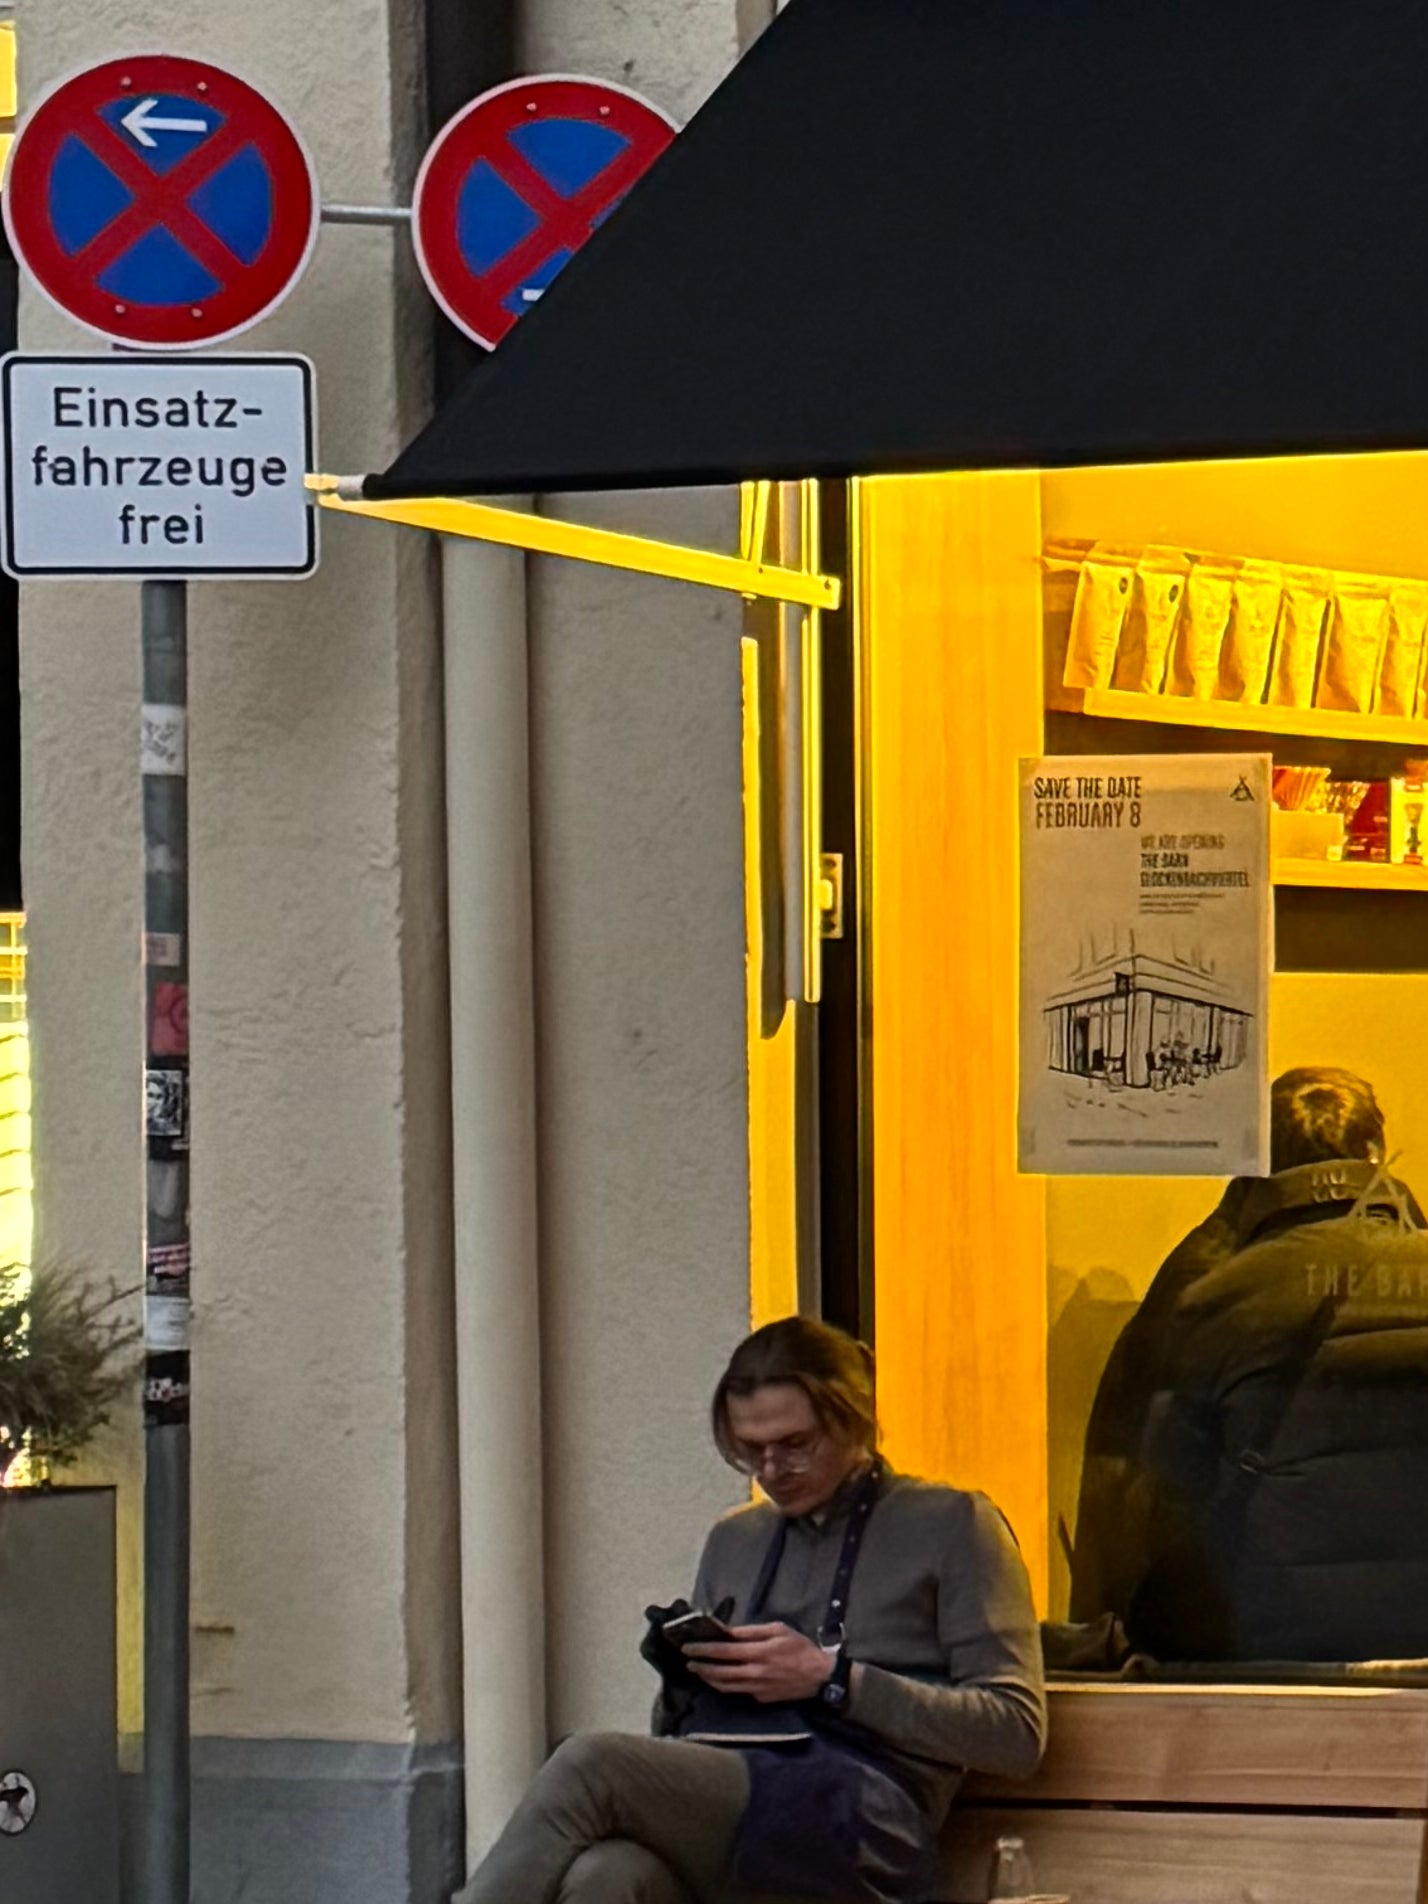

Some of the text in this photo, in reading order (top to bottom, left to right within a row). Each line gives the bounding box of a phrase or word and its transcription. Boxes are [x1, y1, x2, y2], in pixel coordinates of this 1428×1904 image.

[53, 385, 264, 429] Einsatz-
[31, 444, 288, 498] fahrzeuge
[118, 503, 205, 545] frei
[1033, 775, 1143, 800] SAVE THE DATE
[1035, 801, 1142, 830] FEBRUARY 8
[1305, 1262, 1360, 1297] THE
